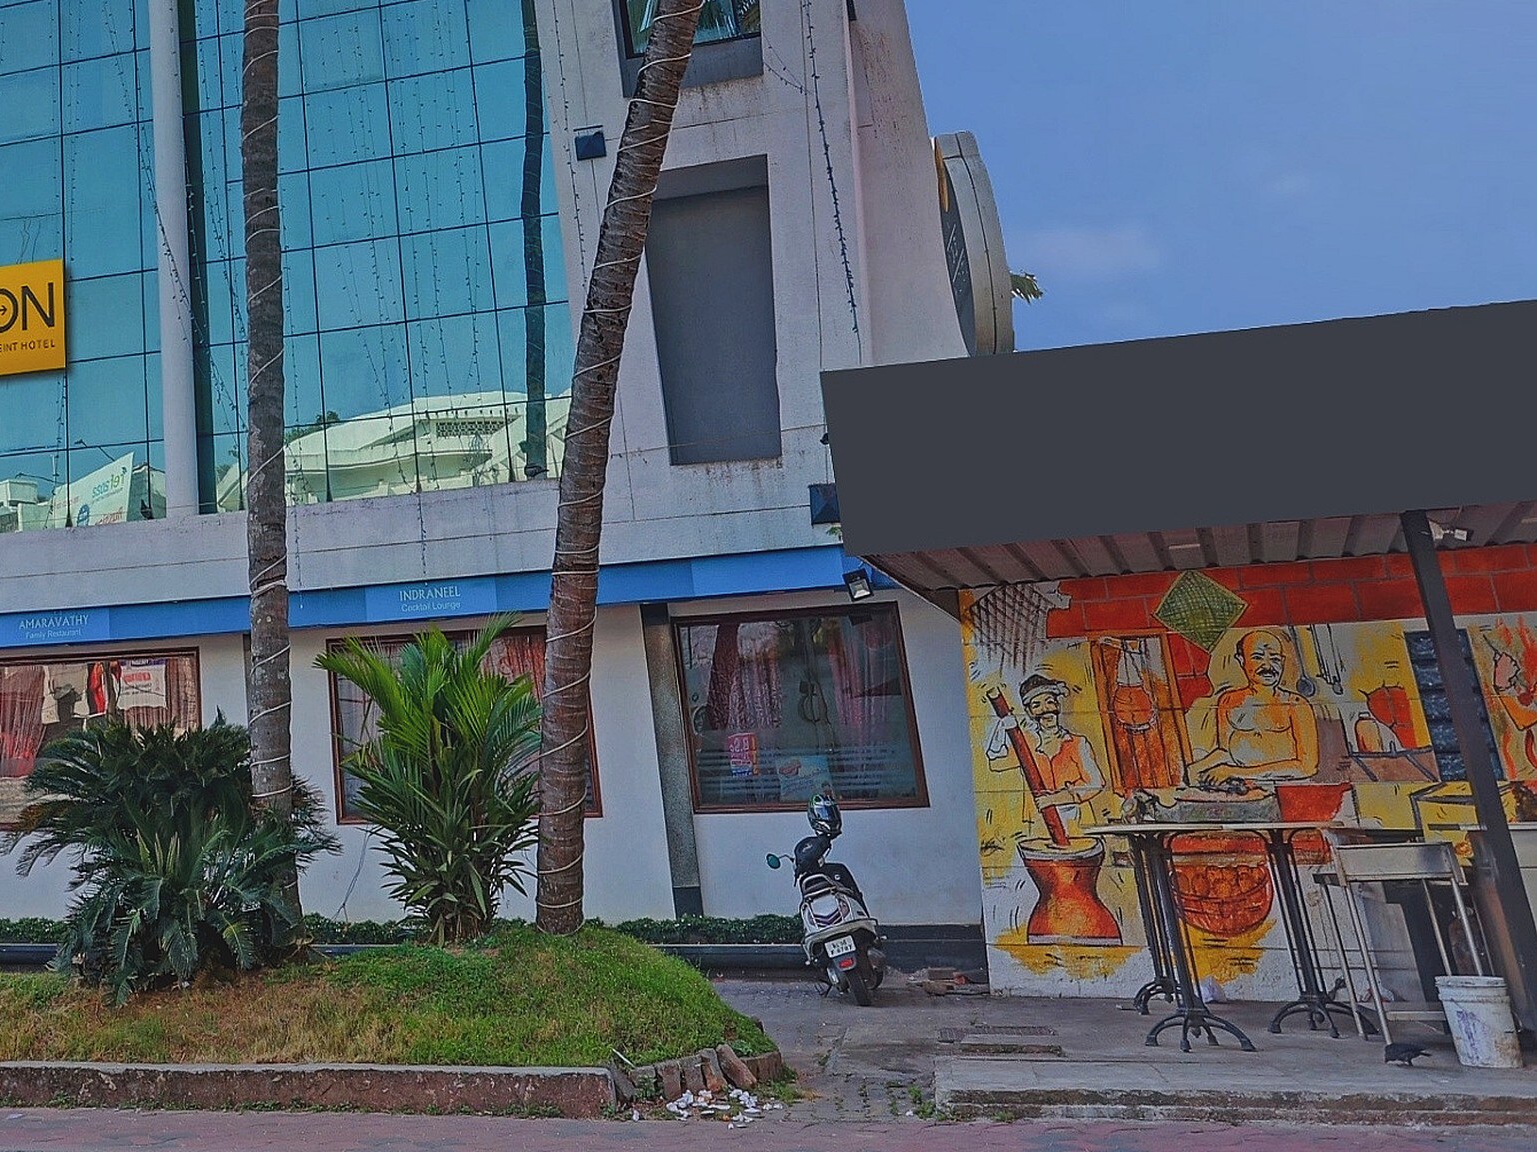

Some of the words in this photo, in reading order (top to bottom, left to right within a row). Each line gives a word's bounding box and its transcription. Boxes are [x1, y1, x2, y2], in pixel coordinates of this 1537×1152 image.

[21, 338, 56, 350] HOTEL
[399, 586, 461, 602] INDRANEEL
[19, 614, 89, 630] AMARAVATHY
